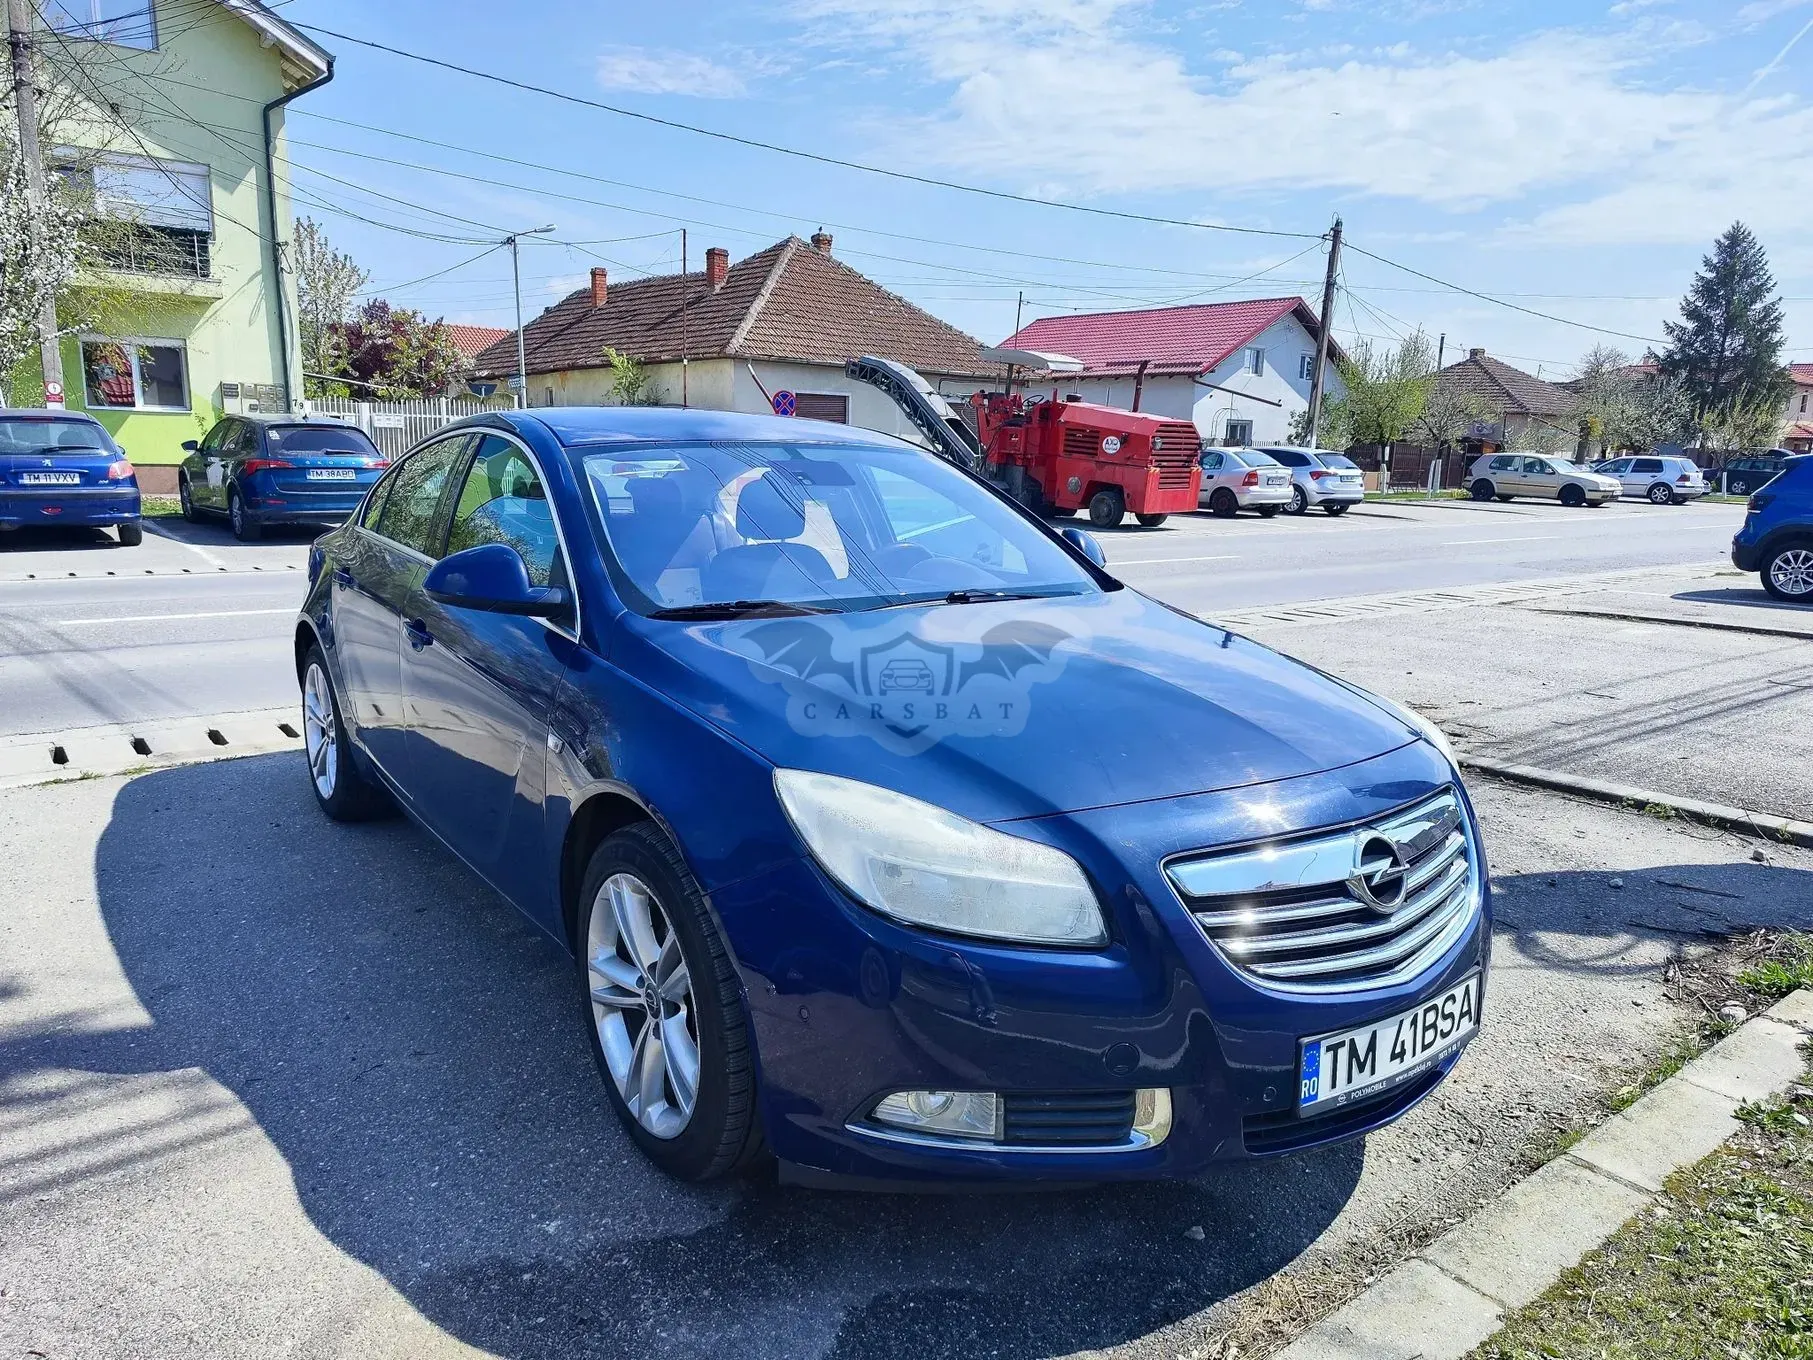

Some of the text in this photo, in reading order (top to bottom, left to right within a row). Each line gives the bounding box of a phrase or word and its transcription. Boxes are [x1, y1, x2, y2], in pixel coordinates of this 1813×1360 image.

[27, 473, 40, 482] TM
[54, 473, 76, 482] VXV
[311, 470, 323, 478] TM
[1325, 983, 1473, 1090] TM 41BSA
[1301, 1077, 1318, 1099] RO
[1351, 1080, 1387, 1100] POLYMOBILE
